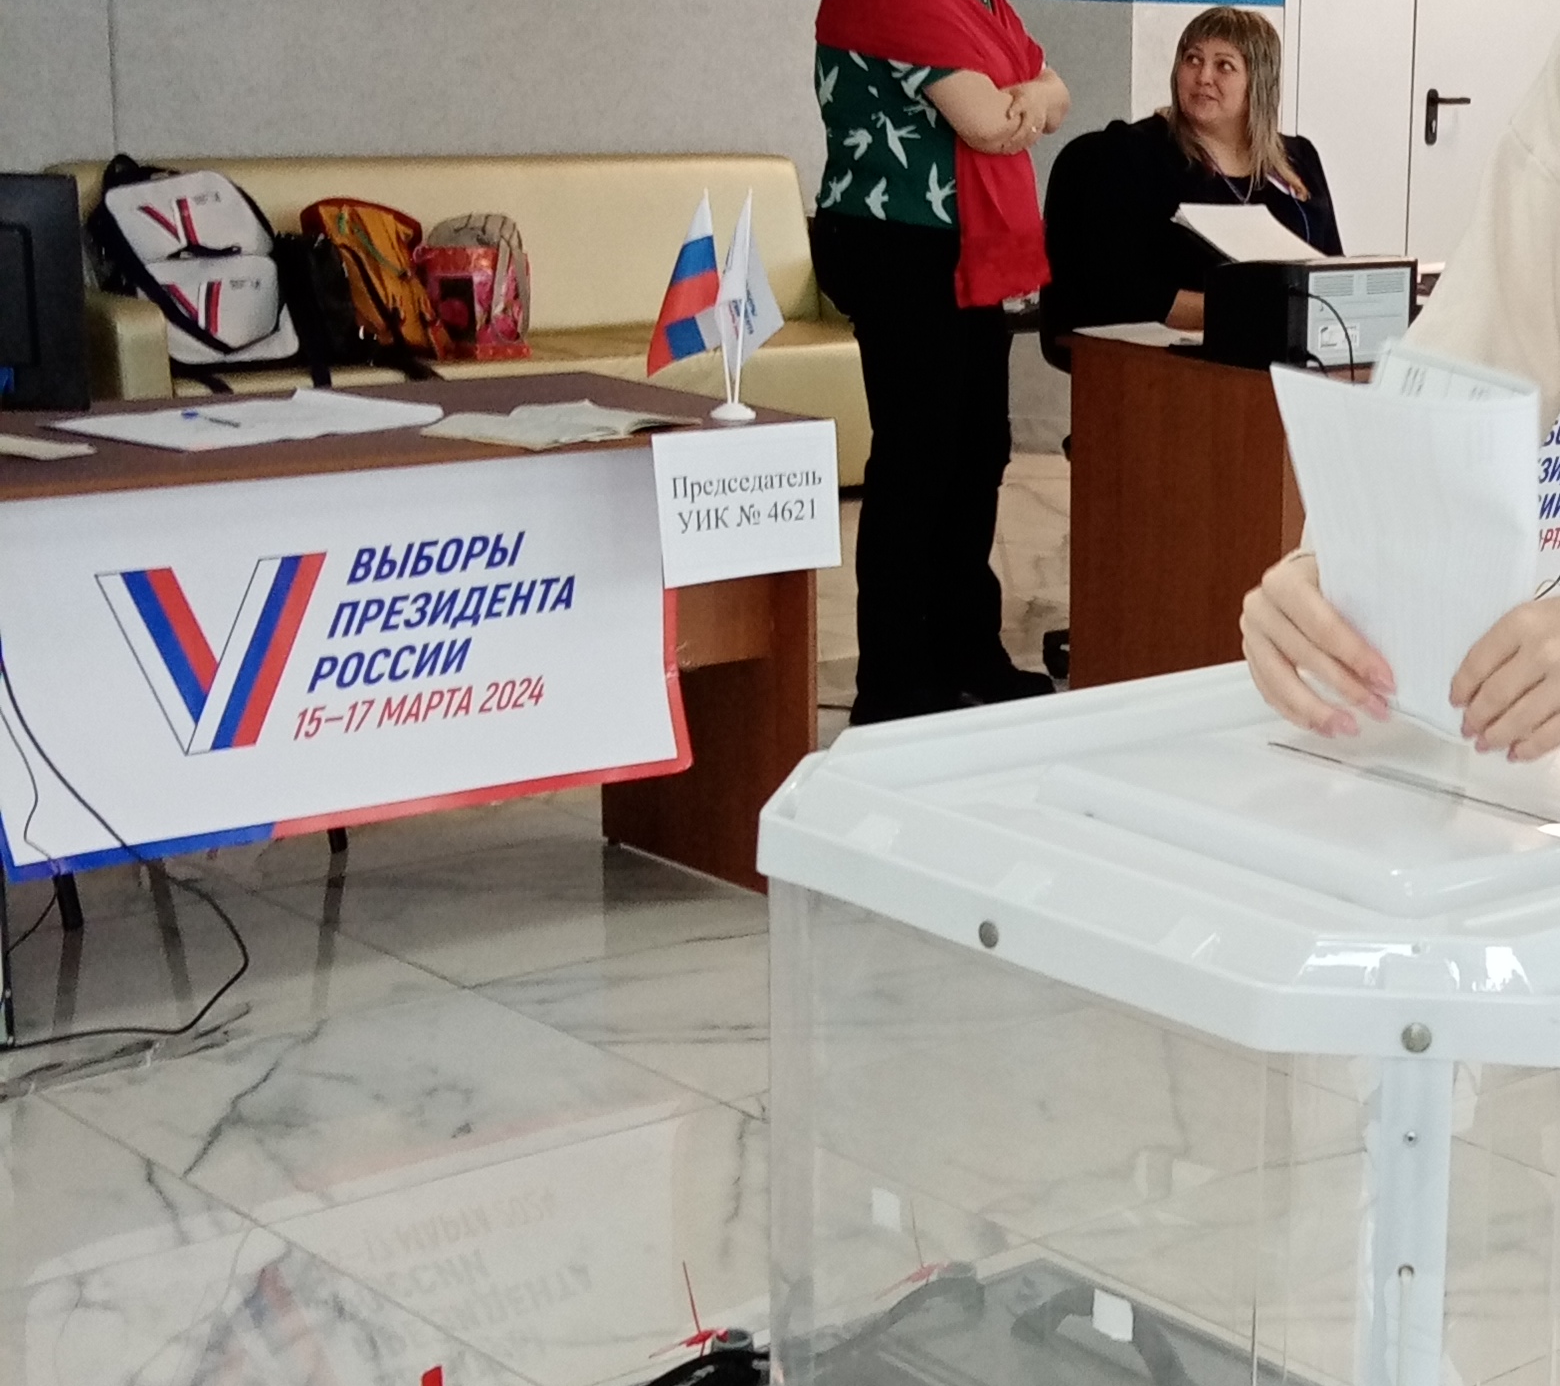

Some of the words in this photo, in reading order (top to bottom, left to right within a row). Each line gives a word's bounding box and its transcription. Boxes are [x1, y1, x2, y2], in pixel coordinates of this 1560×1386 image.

[671, 470, 823, 504] Председатель
[677, 505, 730, 534] УИК
[736, 504, 761, 527] №
[767, 498, 816, 523] 4621
[347, 530, 526, 586] ВЫБОРЫ
[327, 574, 576, 640] ПРЕЗИДЕНТА
[307, 636, 473, 694] РОССИИ
[376, 685, 474, 729] МАРТА
[478, 675, 545, 714] 2024
